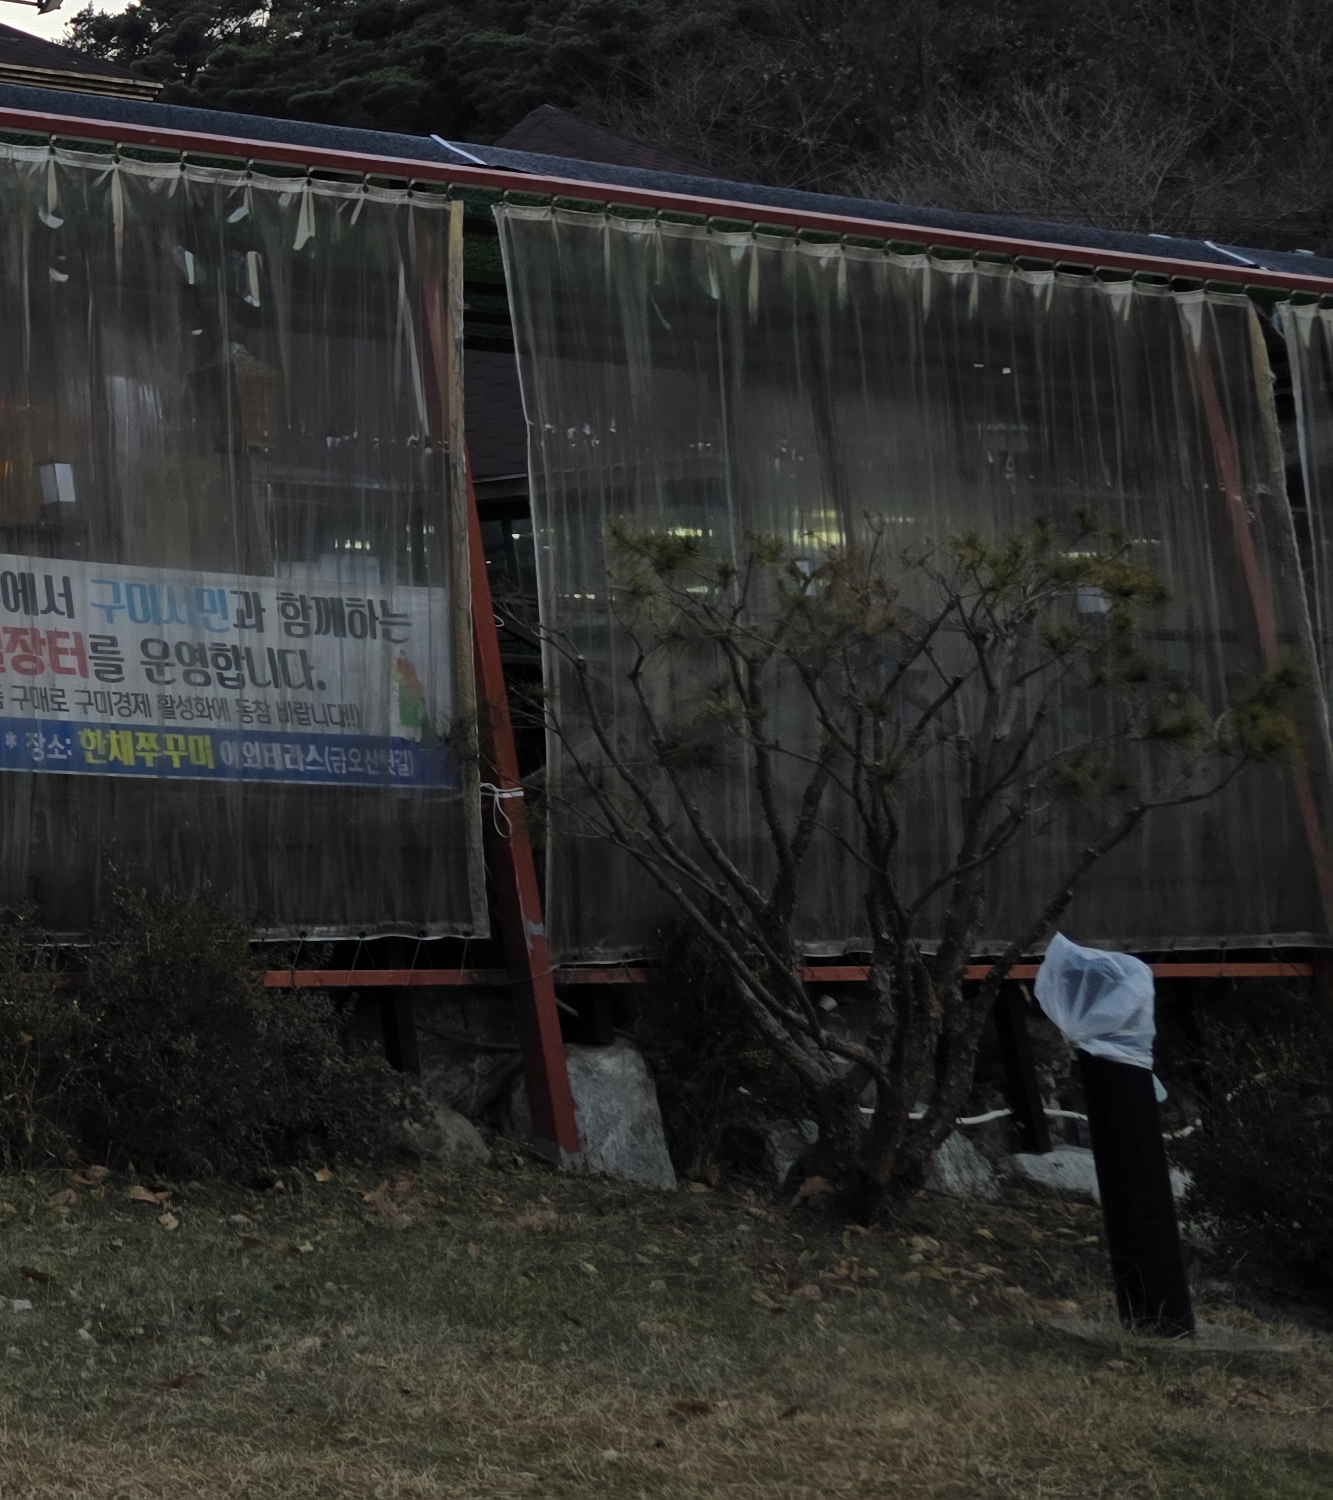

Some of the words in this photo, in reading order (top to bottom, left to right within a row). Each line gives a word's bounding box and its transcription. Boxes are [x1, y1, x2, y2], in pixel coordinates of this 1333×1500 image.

[90, 578, 266, 634] 구미시민과
[275, 590, 413, 645] 함께하는
[139, 636, 328, 692] 운영합니다.
[10, 684, 71, 714] 구매로
[74, 689, 153, 718] 구미경제
[155, 693, 232, 722] 활성화에
[235, 698, 272, 725] 동참
[25, 731, 73, 762] 장소:
[77, 727, 216, 770] 한채쭈꾸미
